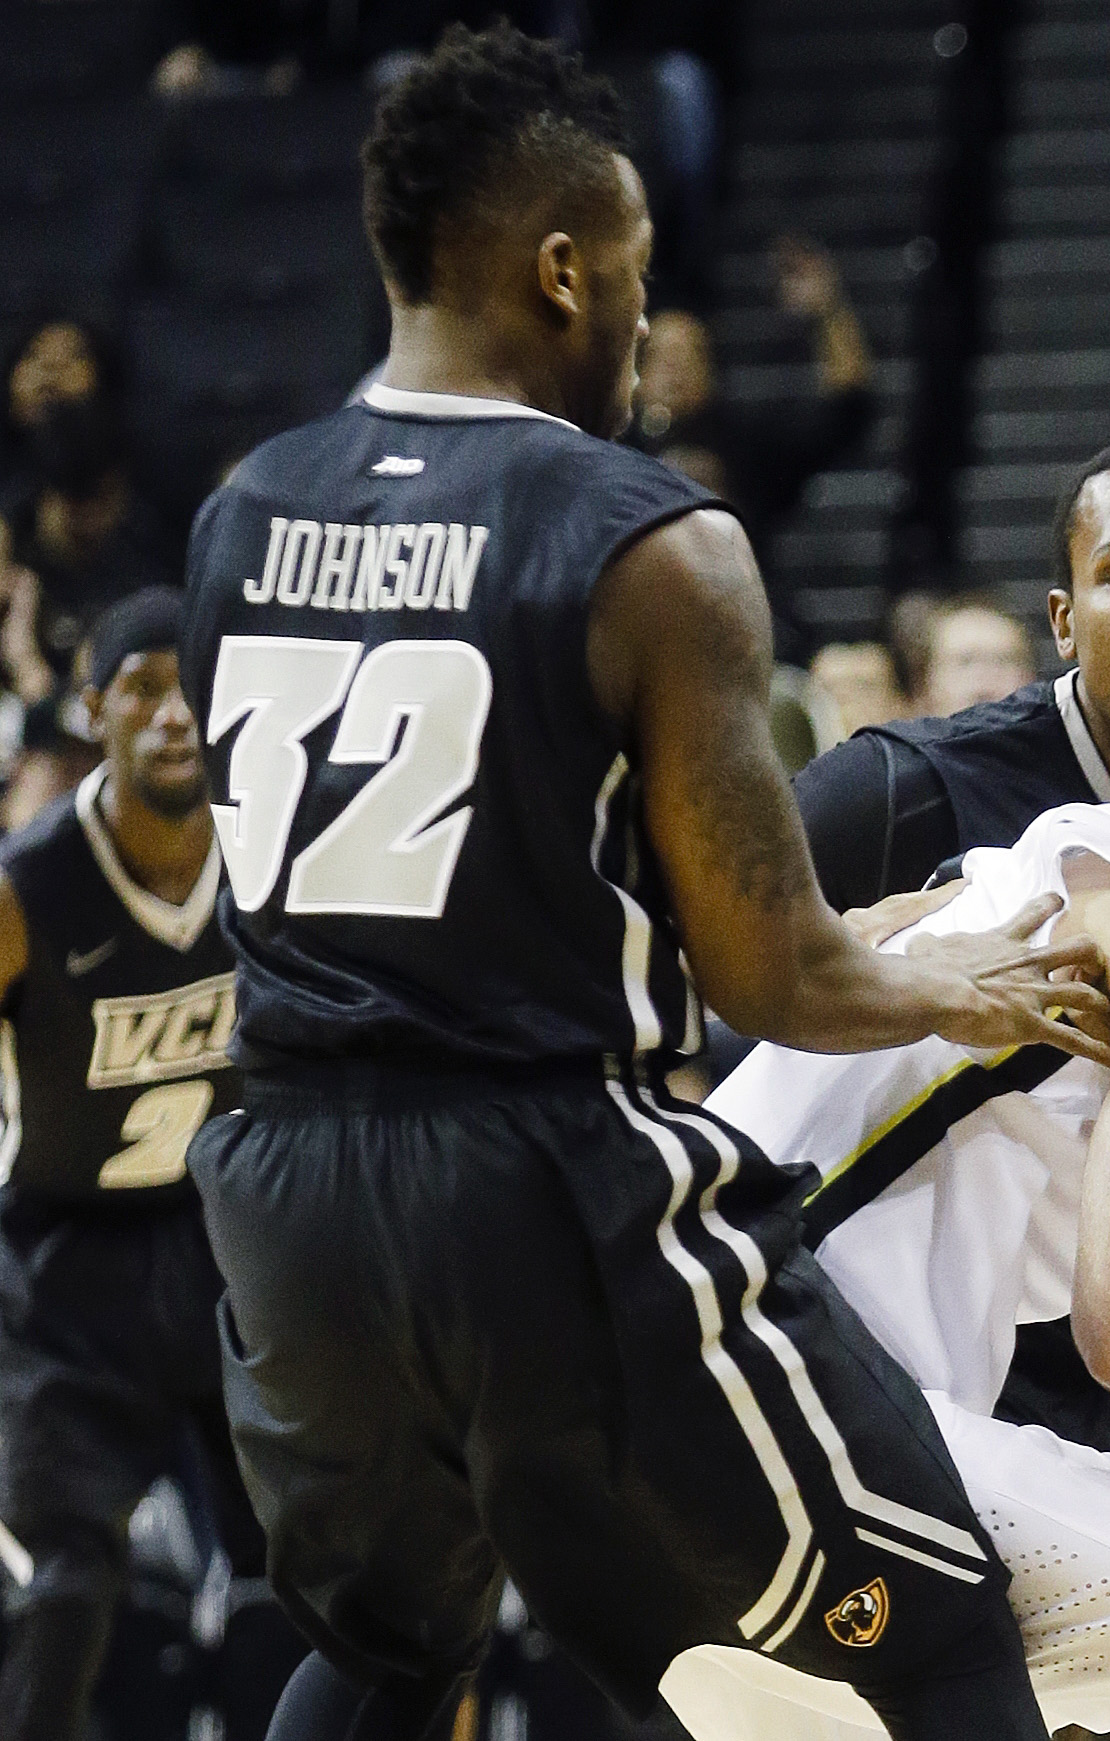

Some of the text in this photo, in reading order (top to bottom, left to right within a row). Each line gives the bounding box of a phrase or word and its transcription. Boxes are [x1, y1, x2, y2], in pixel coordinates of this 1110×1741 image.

[243, 517, 490, 612] JOHNSON
[207, 635, 493, 918] 32
[97, 1079, 215, 1190] 2
